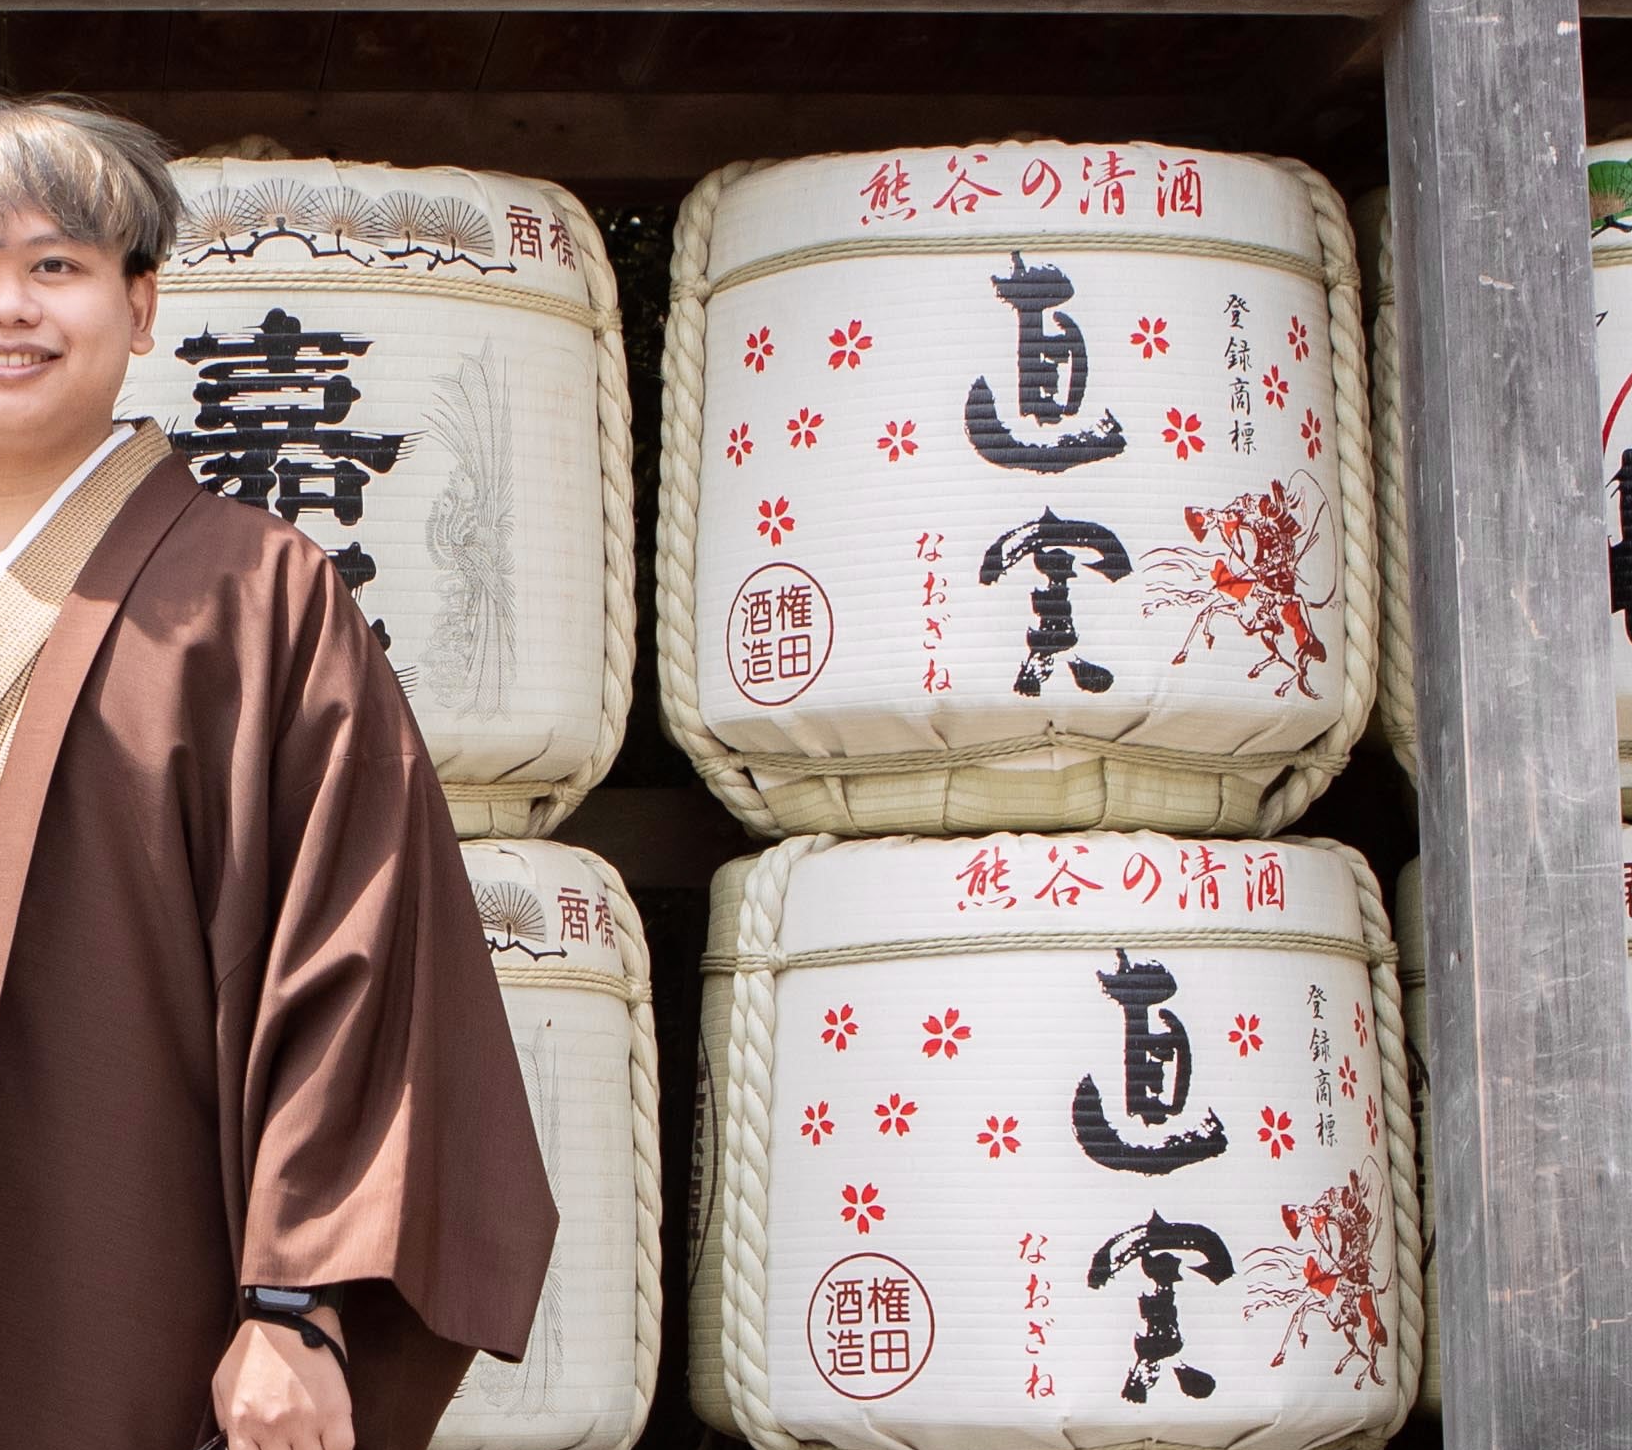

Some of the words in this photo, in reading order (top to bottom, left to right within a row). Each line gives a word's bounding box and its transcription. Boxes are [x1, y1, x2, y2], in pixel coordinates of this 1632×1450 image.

[860, 151, 1203, 227] 熊谷の清酒
[1223, 293, 1257, 455] 登録商標
[741, 585, 774, 685] 酒造
[775, 584, 814, 679] 権田
[915, 531, 954, 693] なおざね
[956, 845, 1285, 913] 熊谷の清酒
[1307, 983, 1337, 1148] 登録商標
[826, 1279, 864, 1377] 酒造
[867, 1277, 911, 1374] 権田
[1018, 1232, 1055, 1400] なおざね
